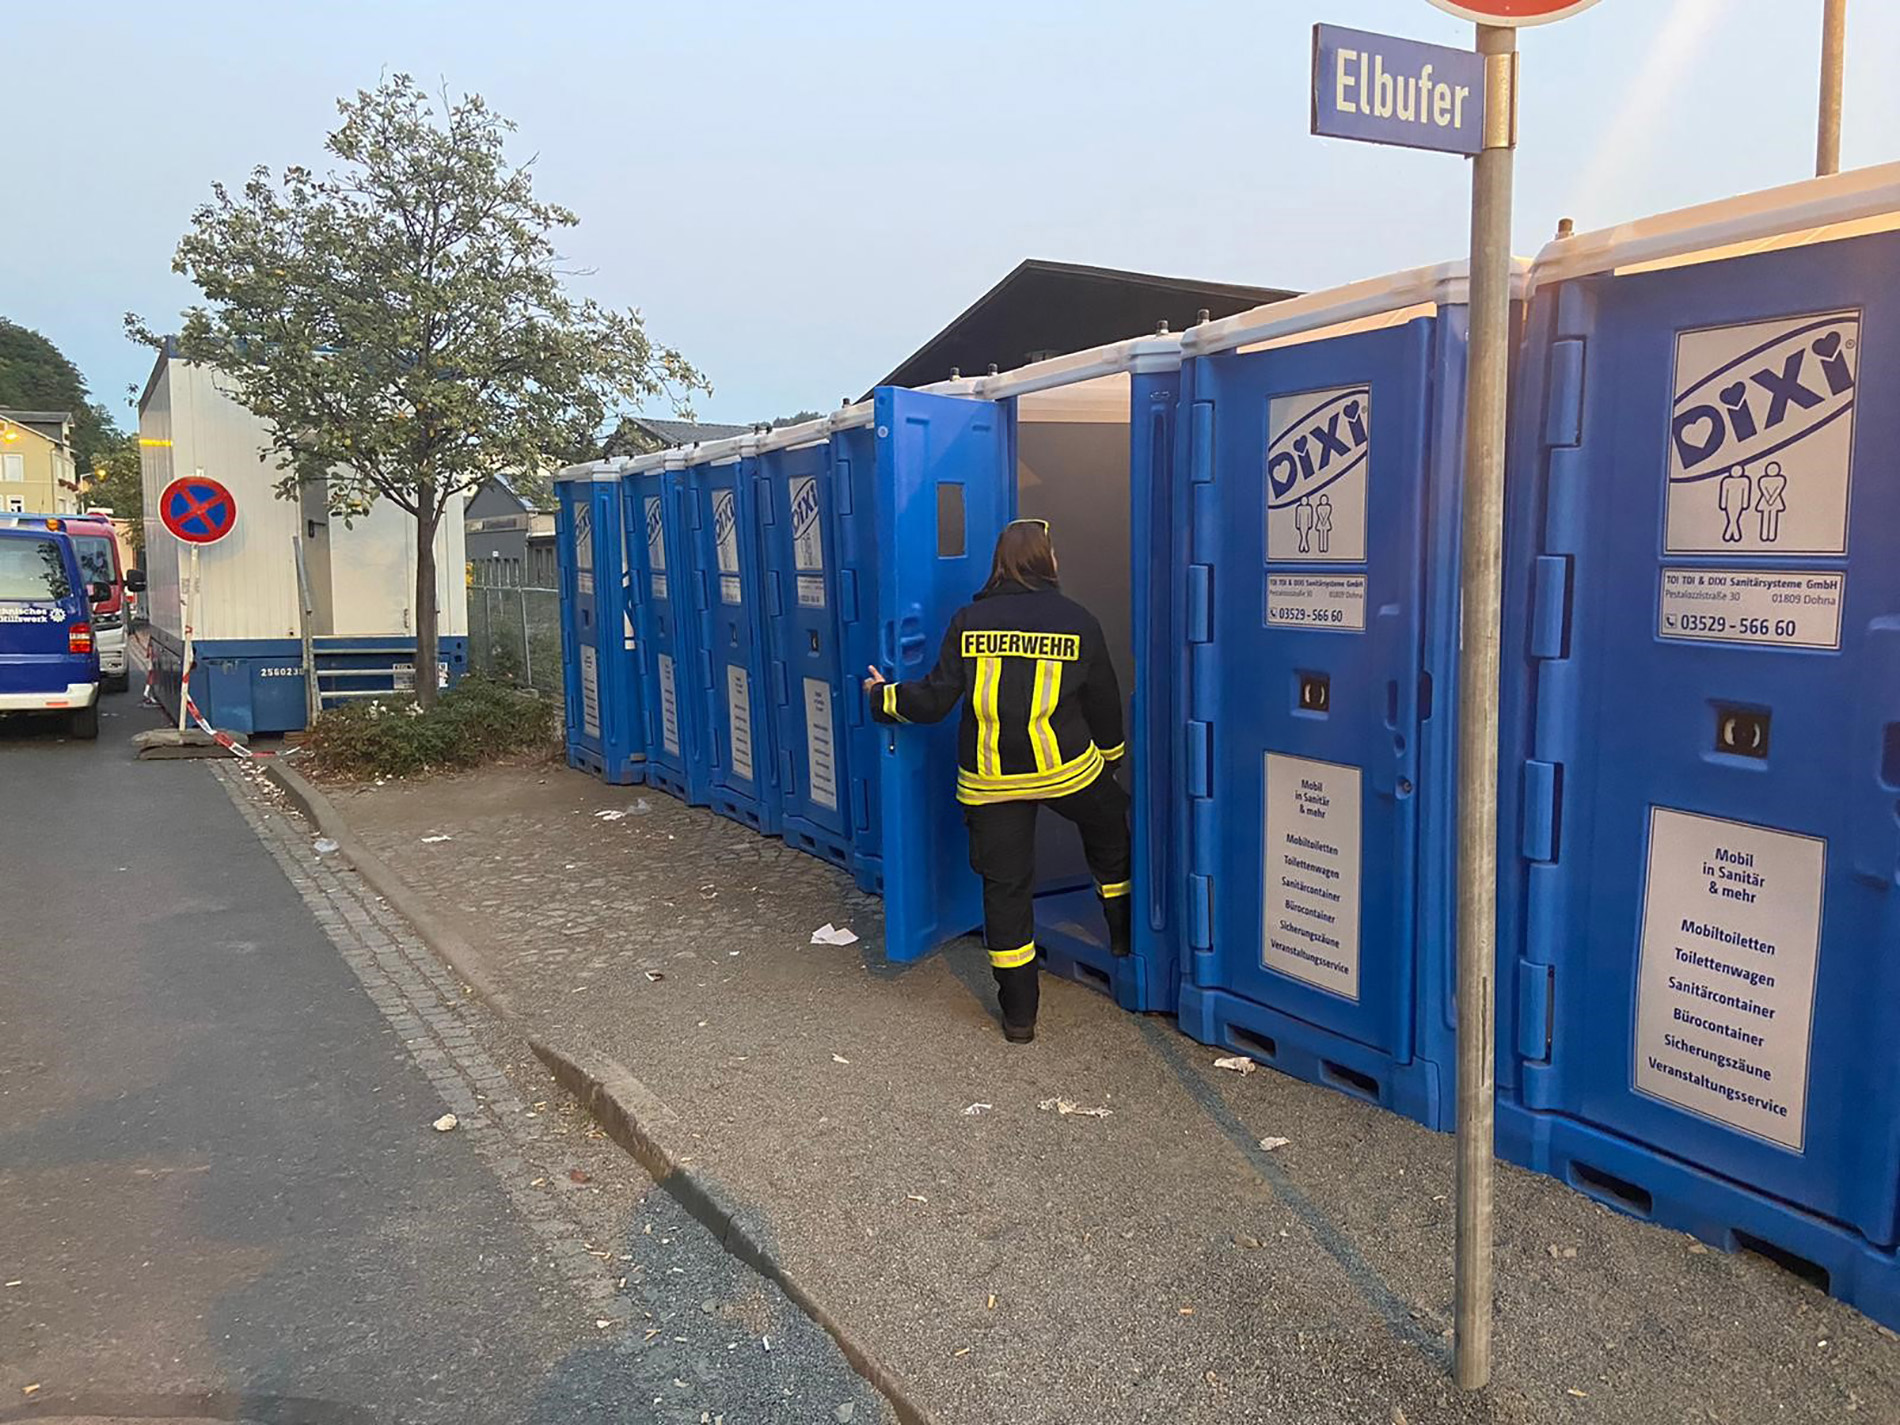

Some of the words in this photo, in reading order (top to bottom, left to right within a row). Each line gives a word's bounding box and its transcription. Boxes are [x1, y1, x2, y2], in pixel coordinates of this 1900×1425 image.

[1336, 48, 1469, 128] Elbufer
[1667, 575, 1679, 585] TOI
[1682, 575, 1695, 585] TOI
[1698, 576, 1704, 585] &
[1708, 576, 1727, 586] DIXI
[1730, 577, 1802, 590] Sanitärsysteme
[1806, 580, 1837, 590] GmbH
[1729, 592, 1740, 601] 30
[1772, 594, 1801, 604] 01809
[1803, 595, 1836, 605] Dohna
[1279, 608, 1305, 620] 03529
[1312, 609, 1329, 621] 566
[1331, 610, 1343, 622] 60
[1681, 615, 1726, 632] 03529
[1739, 618, 1769, 635] 566
[1775, 620, 1796, 636] 60
[964, 633, 1076, 657] FEUERWEHR
[1295, 790, 1302, 800] in
[1304, 791, 1330, 806] Sanitär
[1301, 779, 1323, 792] Mobil
[1299, 804, 1305, 814] &
[1306, 806, 1325, 819] mehr
[1286, 833, 1338, 856] Mobiltoiletten
[1715, 847, 1753, 867] Mobil
[1284, 855, 1340, 880] Toilettenwagen
[1703, 862, 1714, 876] in
[1718, 865, 1765, 888] Sanitär
[1281, 876, 1341, 902] Sanitärcontainer
[1709, 880, 1718, 894] &
[1722, 883, 1757, 904] mehr
[1285, 899, 1335, 924] Bürocontainer
[1279, 920, 1340, 949] Sicherungszäune
[1681, 918, 1776, 956] Mobiltoiletten
[1270, 938, 1349, 975] Veranstaltungsservice
[1675, 947, 1776, 988] Toilettenwagen
[1668, 976, 1776, 1020] Sanitärcontainer
[1673, 1007, 1764, 1048] Bürocontainer
[1664, 1033, 1772, 1082] Sicherungszäune
[1648, 1055, 1788, 1117] Veranstaltungsservice
